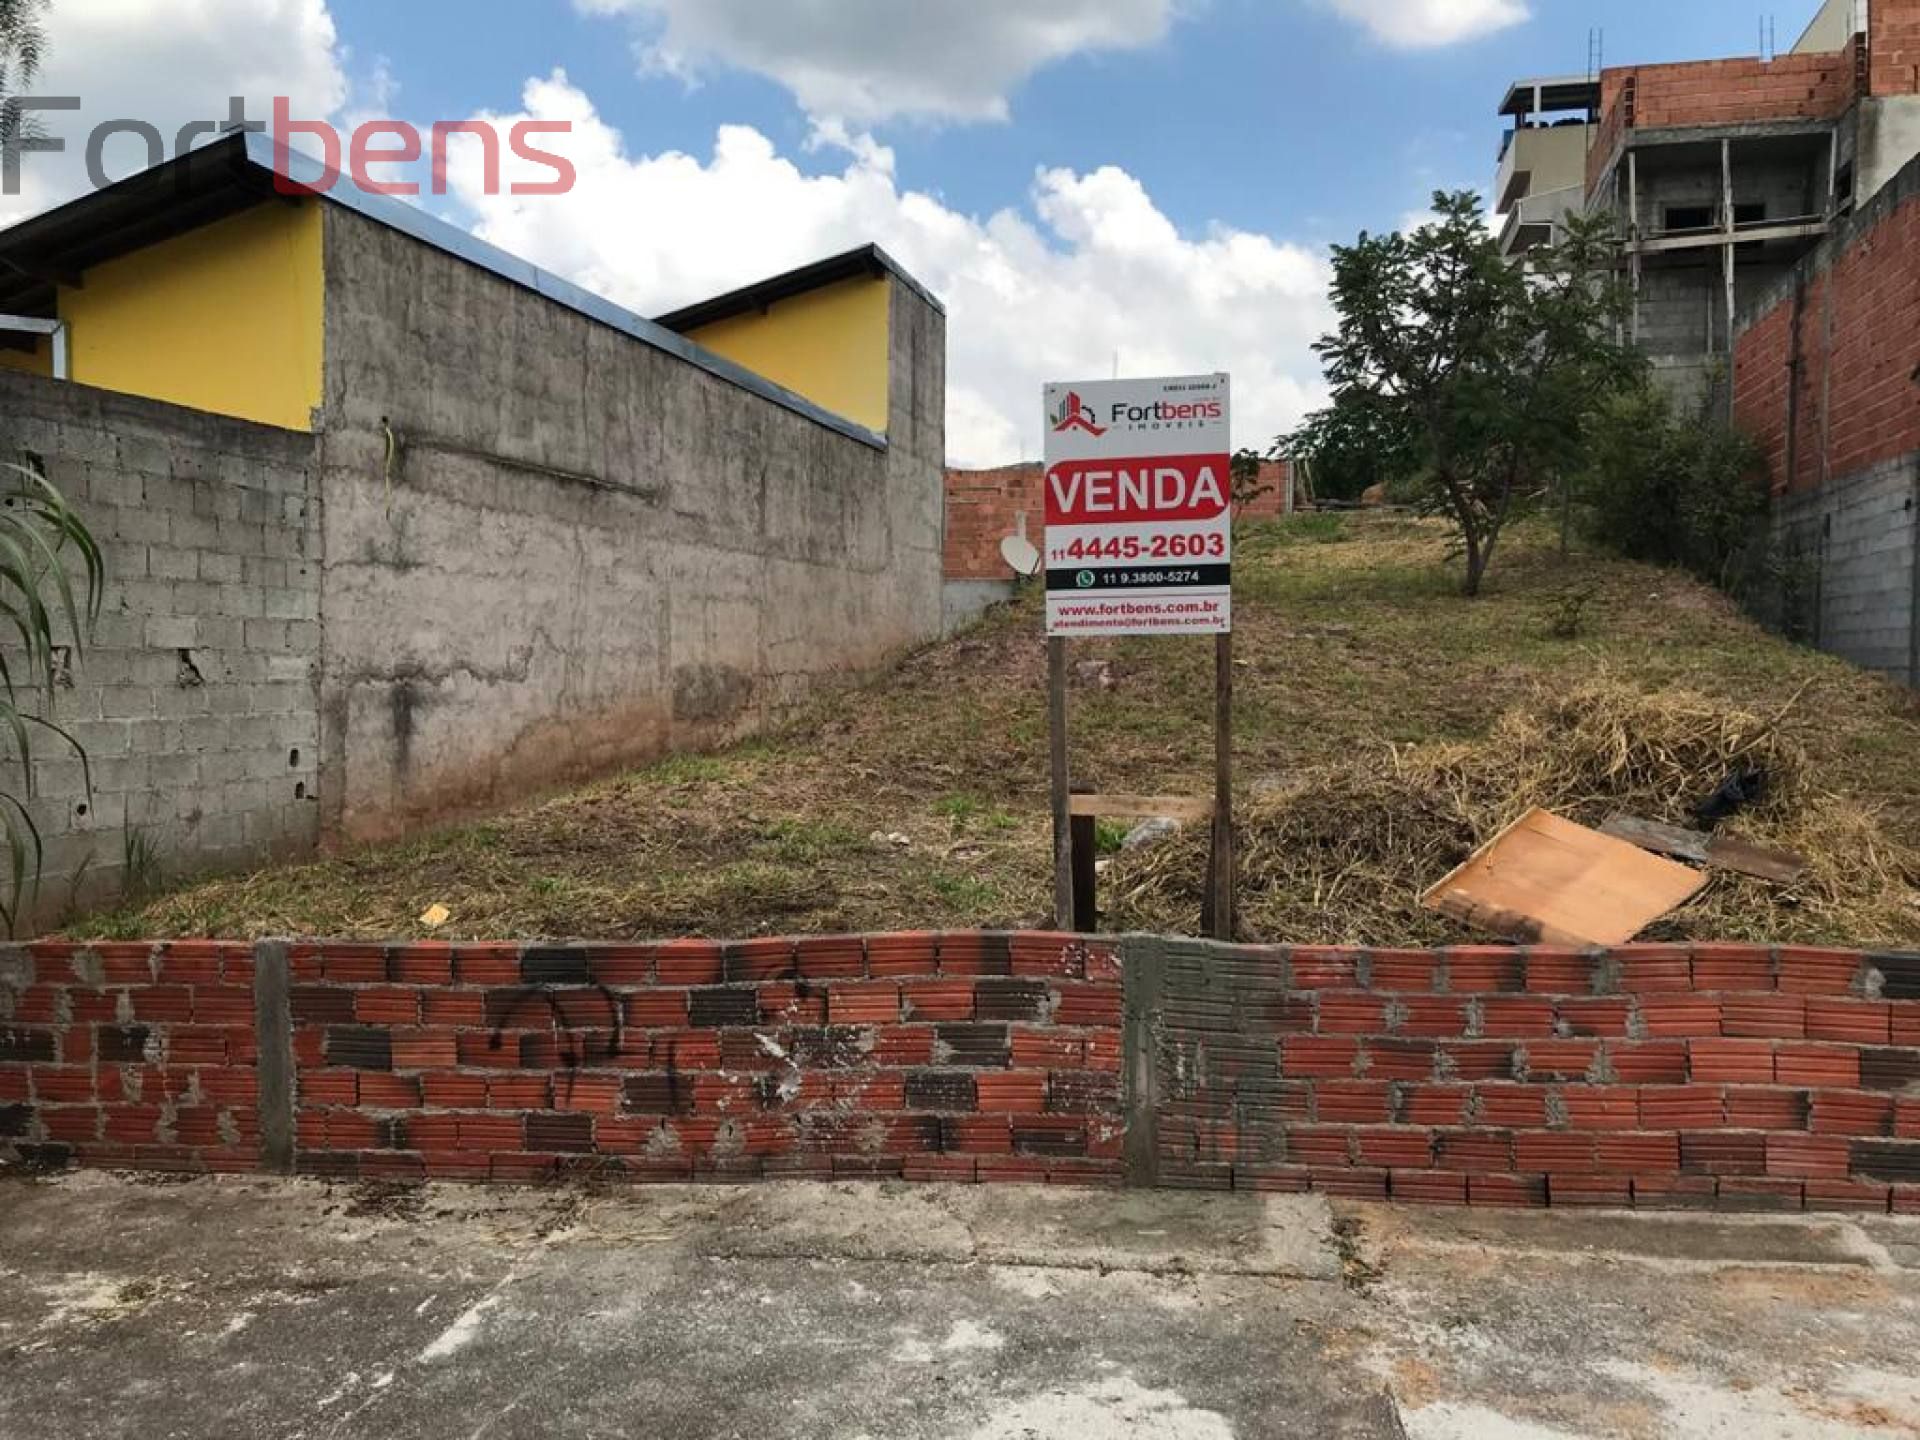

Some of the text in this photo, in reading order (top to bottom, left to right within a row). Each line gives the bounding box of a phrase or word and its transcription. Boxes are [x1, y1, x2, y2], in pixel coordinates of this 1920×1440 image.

[1111, 401, 1222, 422] Fortbens
[1049, 466, 1226, 513] VENDA
[1051, 533, 1225, 560] 11 4445-2603
[1103, 571, 1199, 583] 11 9.3800-5274
[1057, 601, 1219, 616] www.fortbens.com.br
[1053, 617, 1225, 628] atendimento@fortbens.com.br
